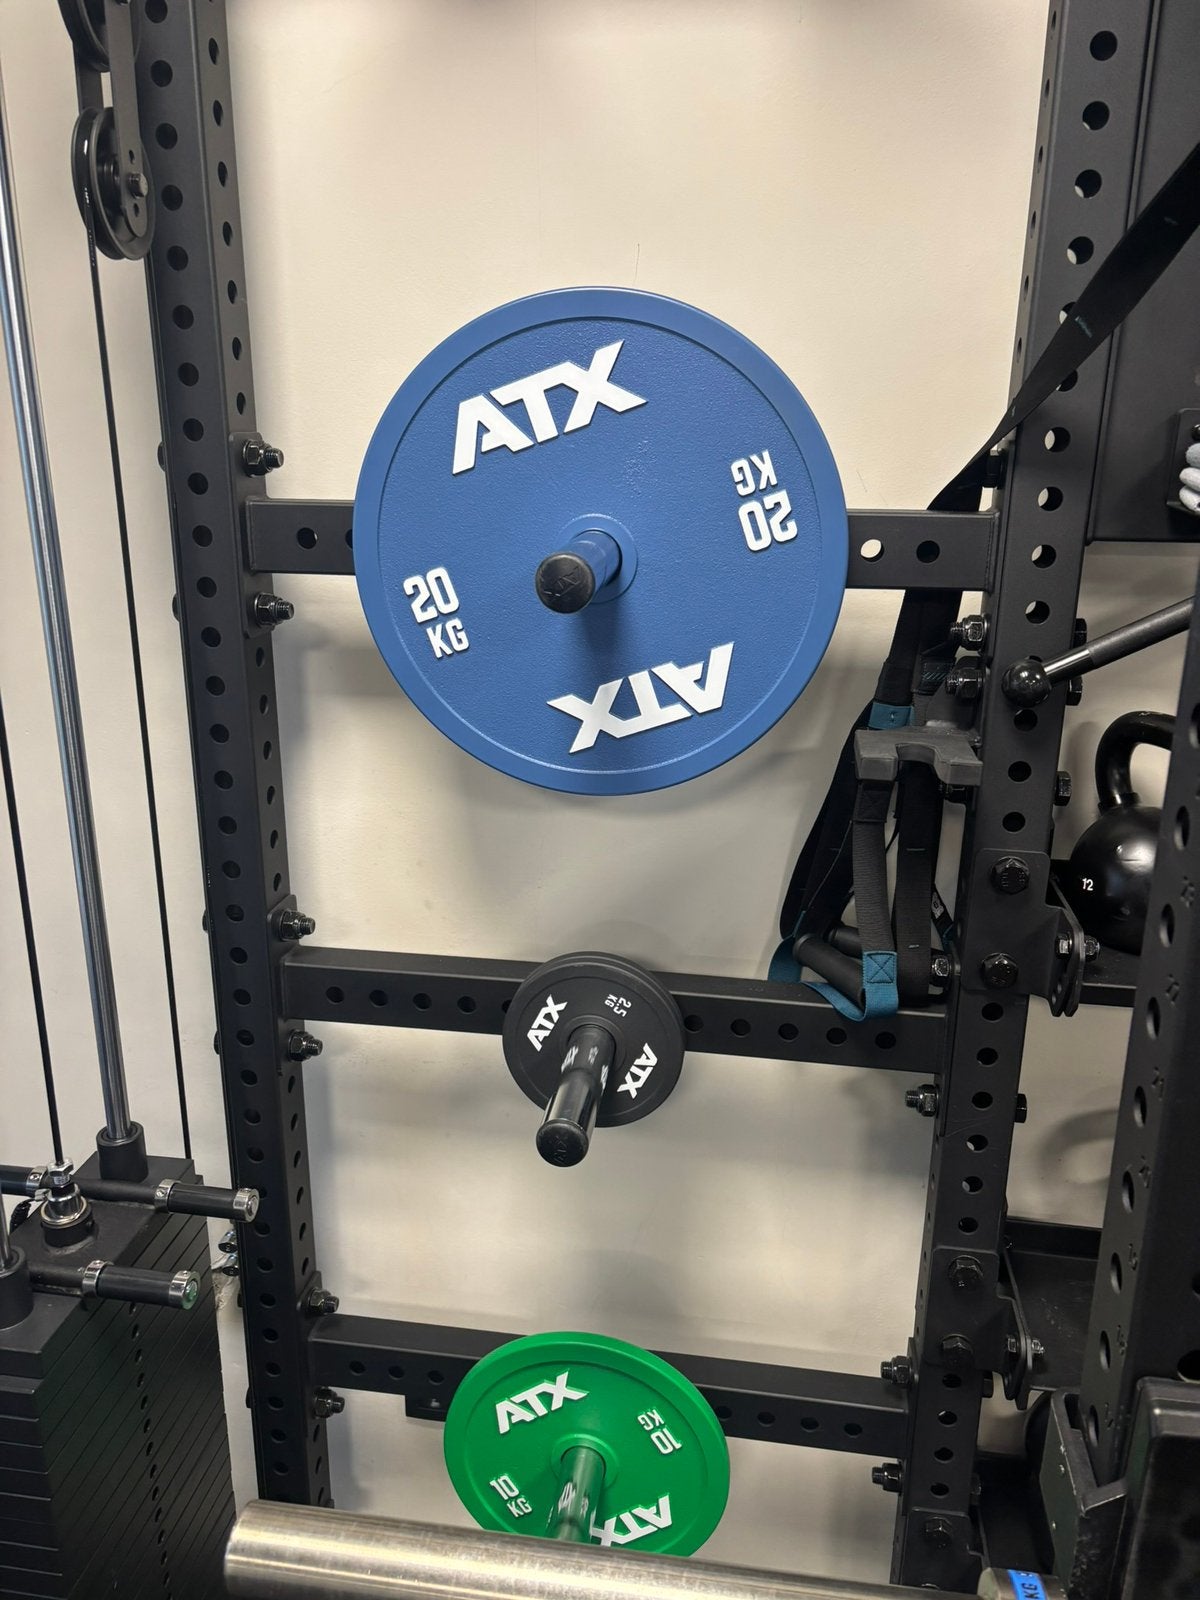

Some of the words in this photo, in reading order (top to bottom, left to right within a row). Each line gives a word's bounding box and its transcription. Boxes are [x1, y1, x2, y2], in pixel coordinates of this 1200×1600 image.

[451, 338, 648, 476] ATX
[730, 449, 779, 498] KG
[738, 489, 799, 553] 20
[402, 566, 460, 625] 20
[425, 618, 470, 660] KG
[546, 641, 736, 755] ATX
[1081, 877, 1095, 891] 12
[526, 993, 569, 1053] ATX
[613, 996, 632, 1018] 2.5
[616, 1042, 659, 1100] ATX
[495, 1370, 590, 1434] ATX
[637, 1408, 665, 1431] KG
[650, 1427, 683, 1456] 10
[488, 1473, 520, 1501] 10
[506, 1496, 534, 1518] KG
